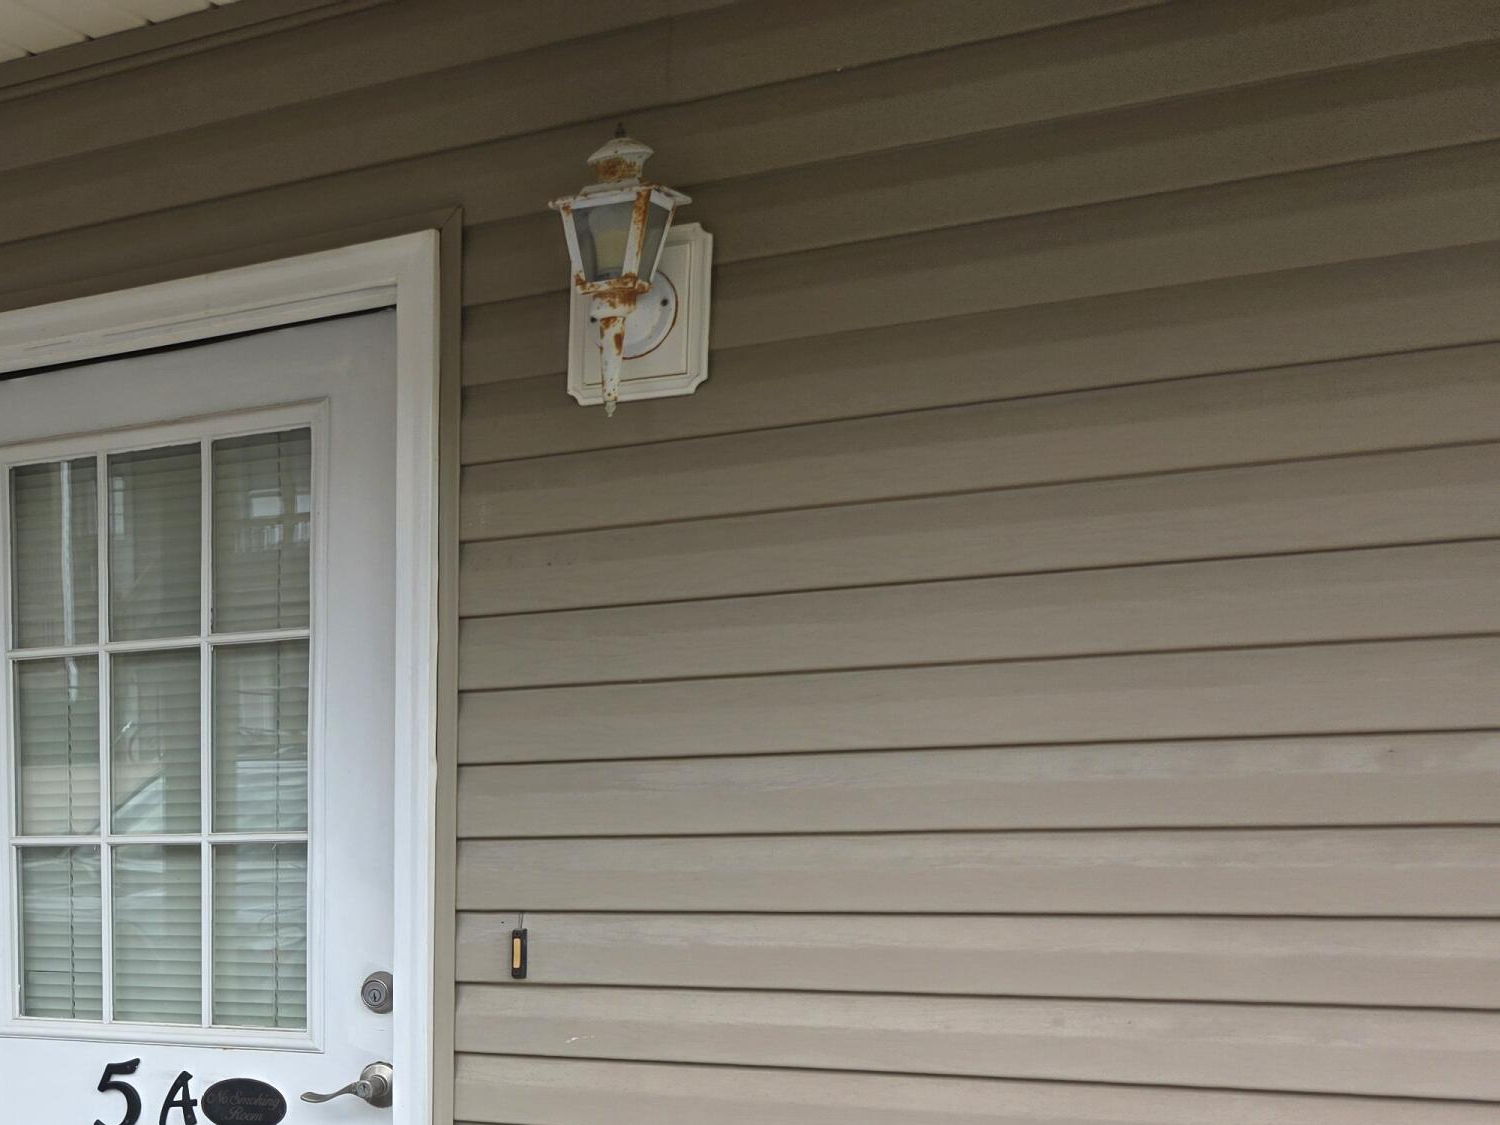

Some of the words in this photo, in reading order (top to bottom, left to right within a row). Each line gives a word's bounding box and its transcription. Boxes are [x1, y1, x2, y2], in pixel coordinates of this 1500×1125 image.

[206, 1089, 228, 1105] No
[229, 1090, 279, 1110] Smoking
[224, 1106, 263, 1121] Room
